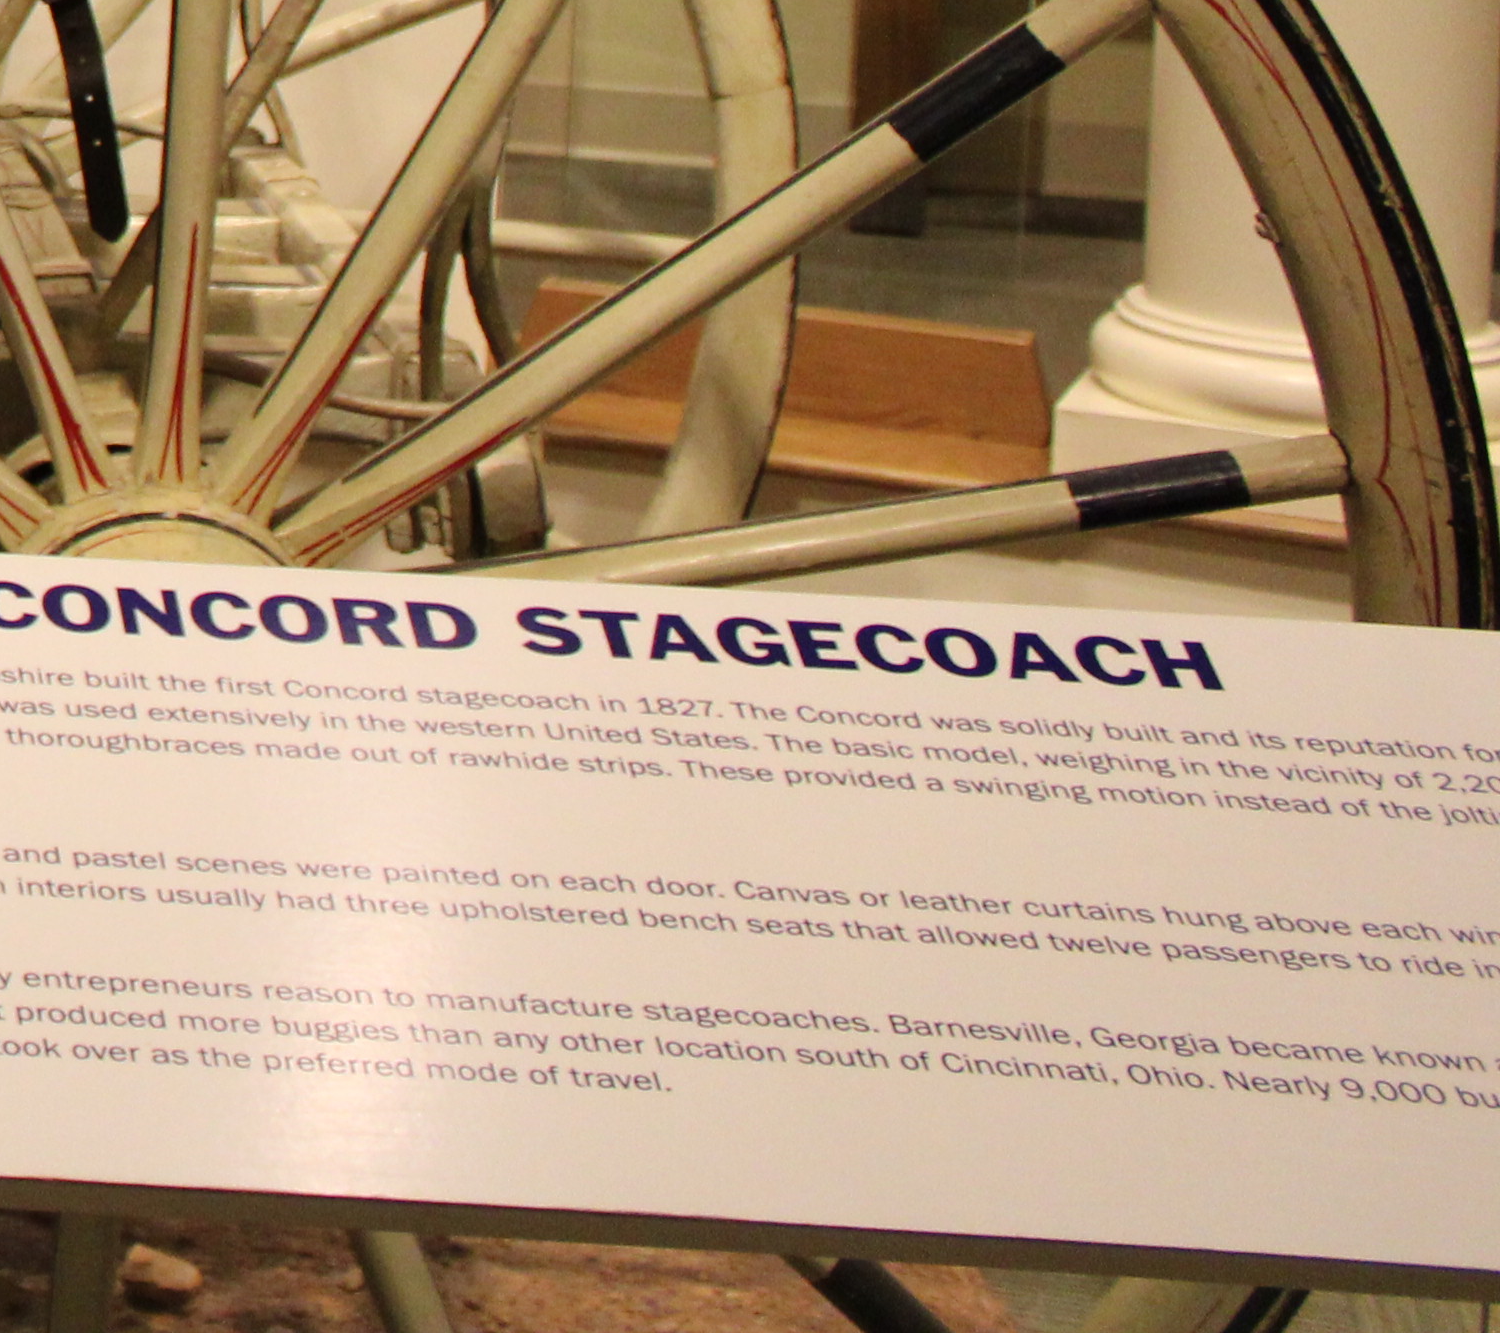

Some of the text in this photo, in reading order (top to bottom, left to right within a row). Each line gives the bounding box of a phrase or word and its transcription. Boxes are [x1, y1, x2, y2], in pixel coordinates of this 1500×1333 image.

[518, 608, 1224, 691] STAGECOACH
[82, 669, 149, 691] built
[155, 673, 206, 694] the
[213, 675, 275, 697] first
[280, 677, 407, 703] Concord
[415, 686, 590, 712] stagecoach
[596, 692, 627, 714] in
[636, 695, 723, 718] 1827.
[727, 699, 787, 722] The
[794, 704, 922, 730] Concord
[929, 715, 992, 734] was
[997, 717, 1094, 744] solidly
[1101, 721, 1174, 744] built
[1179, 728, 1240, 748] and
[1246, 729, 1289, 752] its
[1293, 736, 1457, 761] reputation
[21, 969, 251, 999] entrepreneurs
[261, 982, 373, 1005] reason
[379, 986, 415, 1008] to
[425, 991, 633, 1020] manufacture
[642, 1001, 878, 1034] stagecoaches.
[887, 1013, 1082, 1049] Barnesville,
[1089, 1025, 1220, 1058] Georgia
[1226, 1034, 1365, 1065] became
[1371, 1043, 1487, 1073] known
[69, 1042, 139, 1063] over
[149, 1046, 189, 1067] as
[195, 1045, 251, 1070] the
[261, 1050, 414, 1078] preferred
[425, 1060, 518, 1084] mode
[527, 1063, 559, 1087] of
[567, 1066, 672, 1093] travel.
